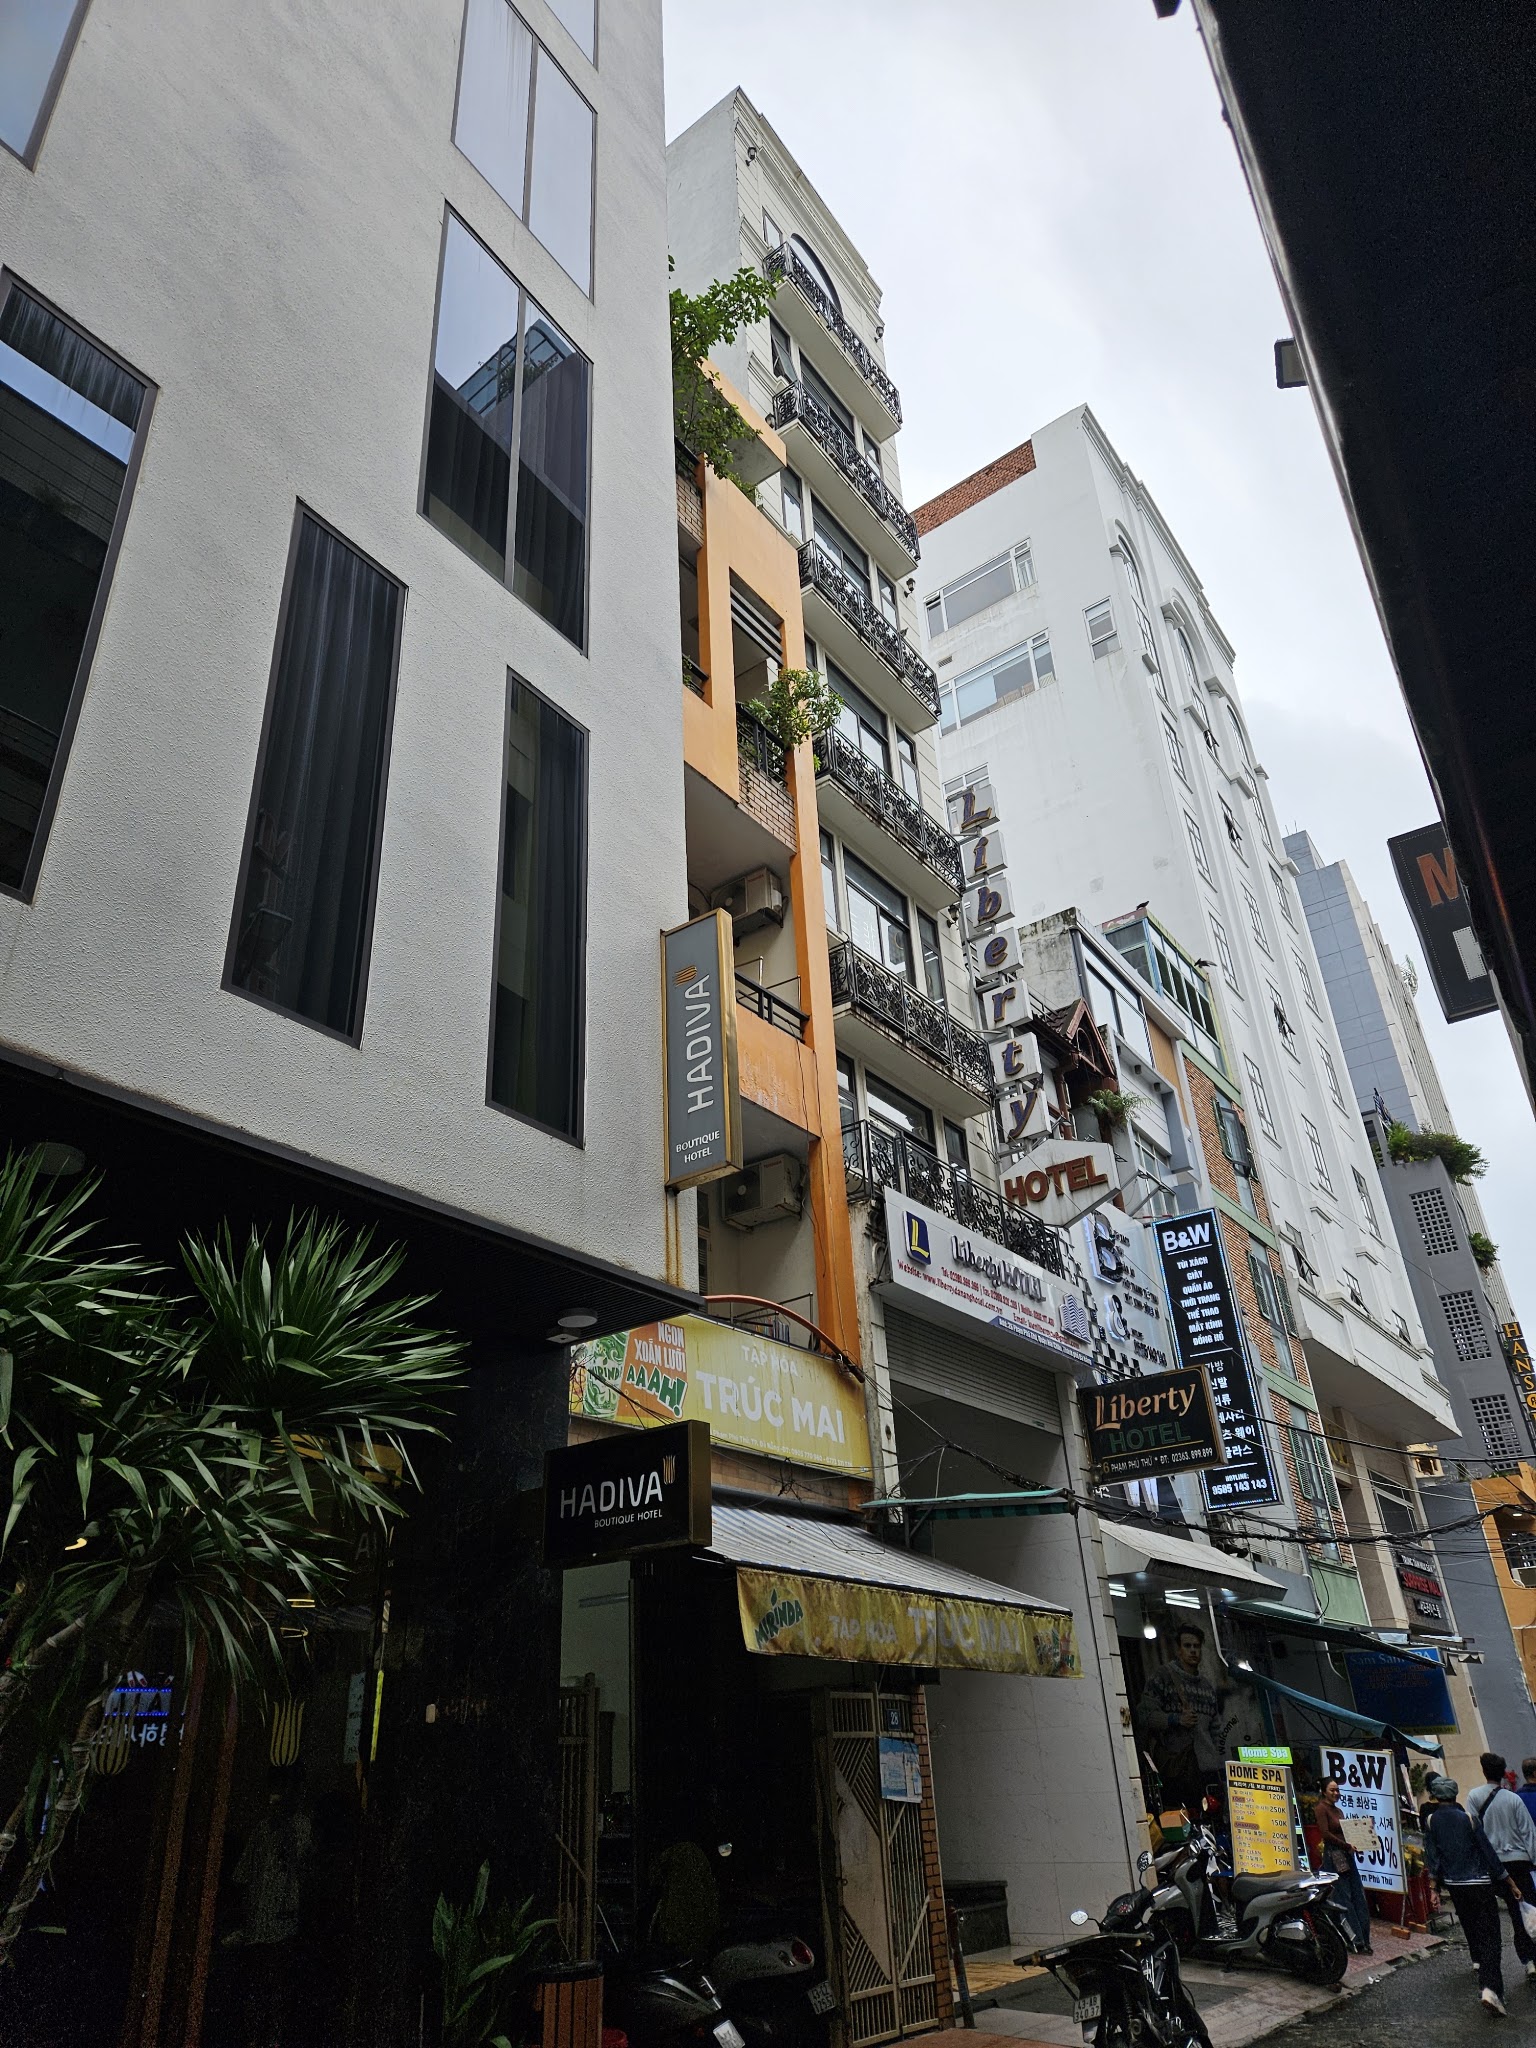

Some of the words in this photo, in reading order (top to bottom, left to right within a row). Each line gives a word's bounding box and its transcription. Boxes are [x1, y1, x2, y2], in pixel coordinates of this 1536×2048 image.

[684, 974, 714, 1114] HADIVA
[675, 1130, 720, 1153] BOUTIQUE
[684, 1147, 712, 1163] HOTEL
[1003, 1155, 1109, 1206] HOTEL
[1162, 1222, 1210, 1252] B&W
[657, 1321, 685, 1348] NGON
[695, 1370, 785, 1427] TRÚC
[791, 1397, 845, 1444] MAI
[1095, 1383, 1196, 1432] Liberty
[1108, 1421, 1191, 1453] HOTEL
[560, 1471, 663, 1519] HADIVA
[594, 1513, 635, 1528] BOUTIQUE
[637, 1509, 663, 1522] HOTEL
[754, 1599, 804, 1650] MIRINDA
[978, 1617, 1022, 1655] MAI
[890, 1711, 899, 1725] 28
[1242, 1748, 1268, 1759] Home
[1270, 1748, 1288, 1760] Spa
[1229, 1765, 1258, 1780] HOME
[1262, 1768, 1282, 1783] SPA
[1326, 1751, 1387, 1790] B&W
[1269, 1793, 1285, 1801] 120K
[1270, 1806, 1286, 1814] 250K
[1271, 1819, 1287, 1827] 150K
[1272, 1832, 1289, 1840] 200K
[1273, 1845, 1290, 1853] 150K
[1274, 1858, 1291, 1866] 150K
